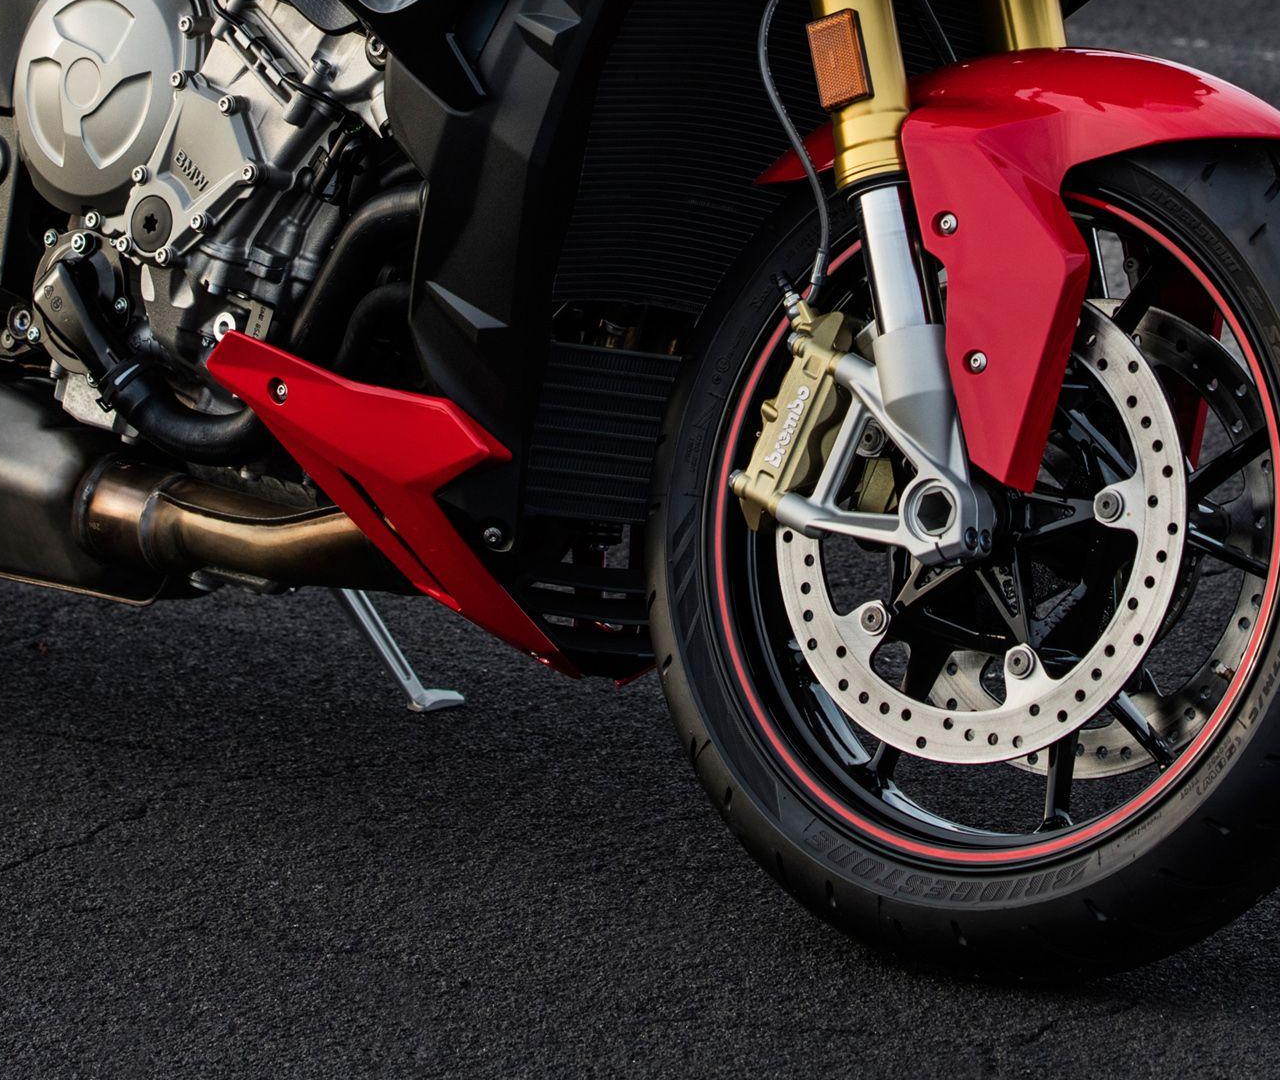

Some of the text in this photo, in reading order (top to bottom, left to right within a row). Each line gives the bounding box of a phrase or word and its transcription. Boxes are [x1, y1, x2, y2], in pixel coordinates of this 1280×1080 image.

[174, 148, 209, 191] BMW
[764, 386, 810, 468] brembo
[806, 829, 1092, 903] BRIDGESTONE
